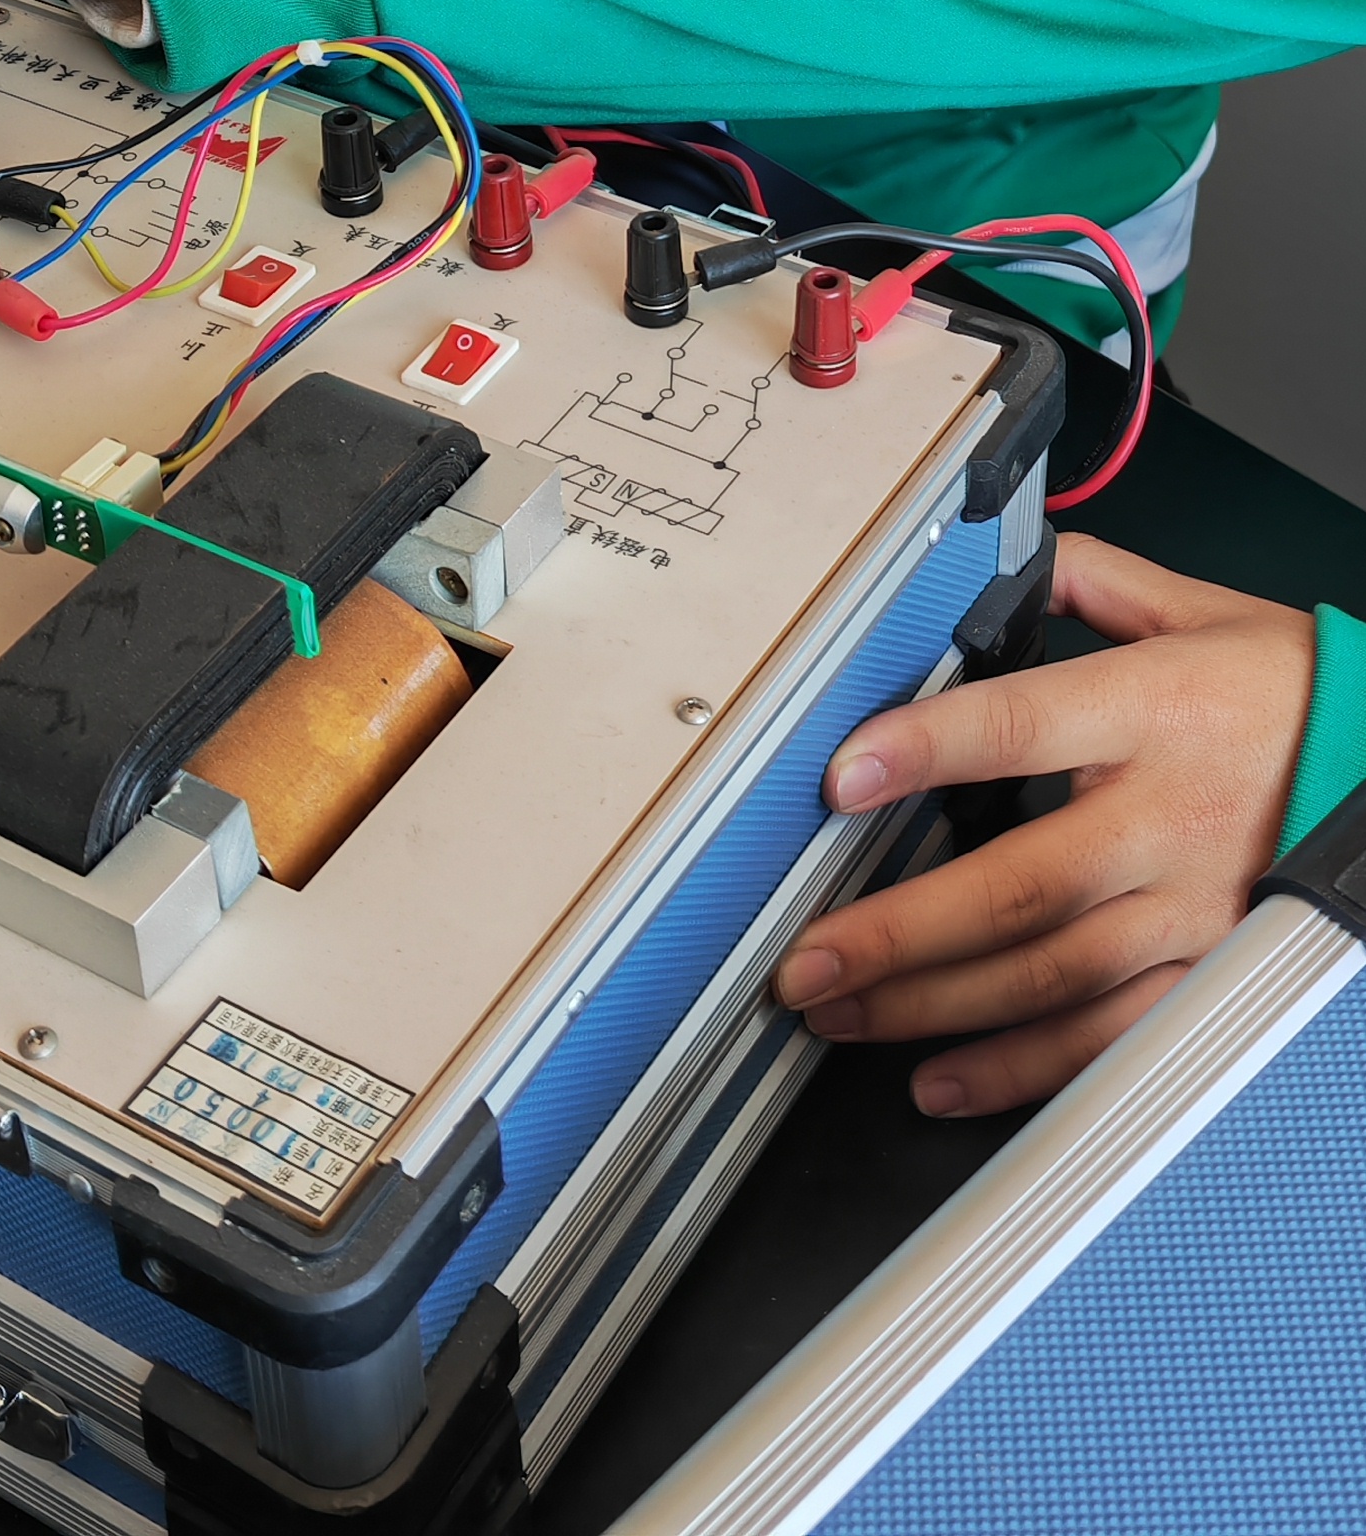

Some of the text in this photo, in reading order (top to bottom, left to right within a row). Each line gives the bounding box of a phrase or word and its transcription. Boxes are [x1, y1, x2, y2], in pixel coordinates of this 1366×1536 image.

[184, 219, 230, 251] 电源
[343, 223, 465, 278] 数字压表
[201, 321, 231, 337] 正
